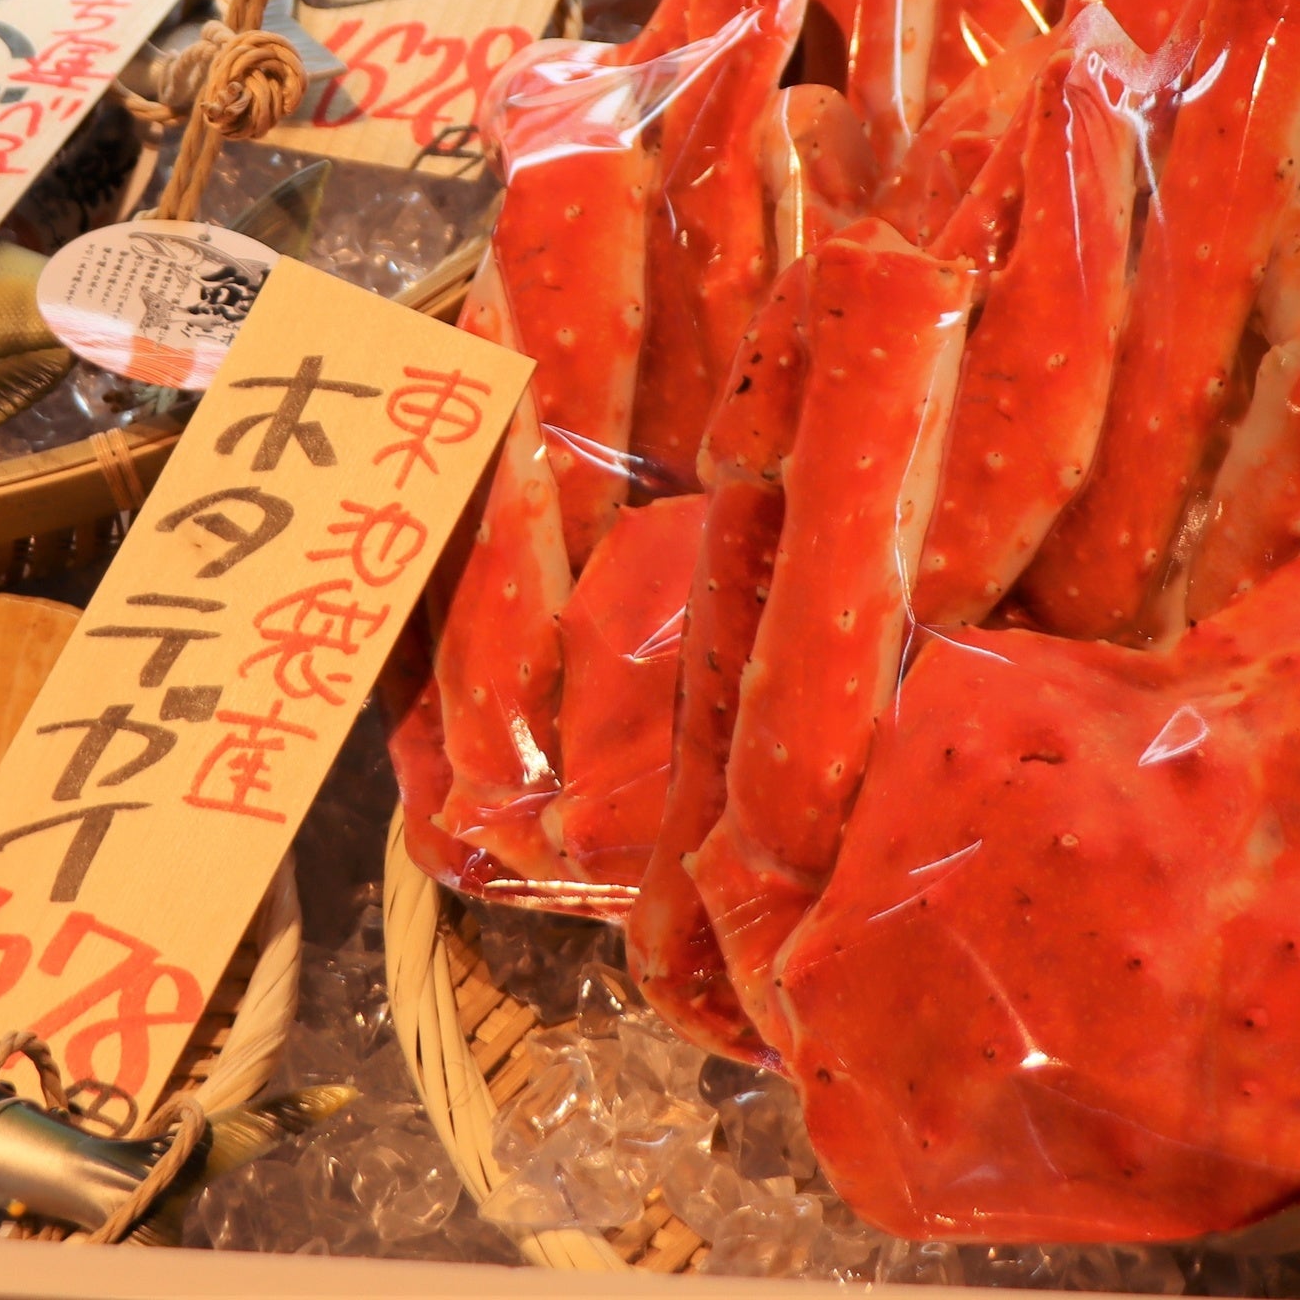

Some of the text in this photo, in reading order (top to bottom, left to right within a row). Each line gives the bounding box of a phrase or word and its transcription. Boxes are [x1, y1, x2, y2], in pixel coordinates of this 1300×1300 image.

[312, 19, 533, 152] 1628
[181, 366, 492, 824] 東池袋産
